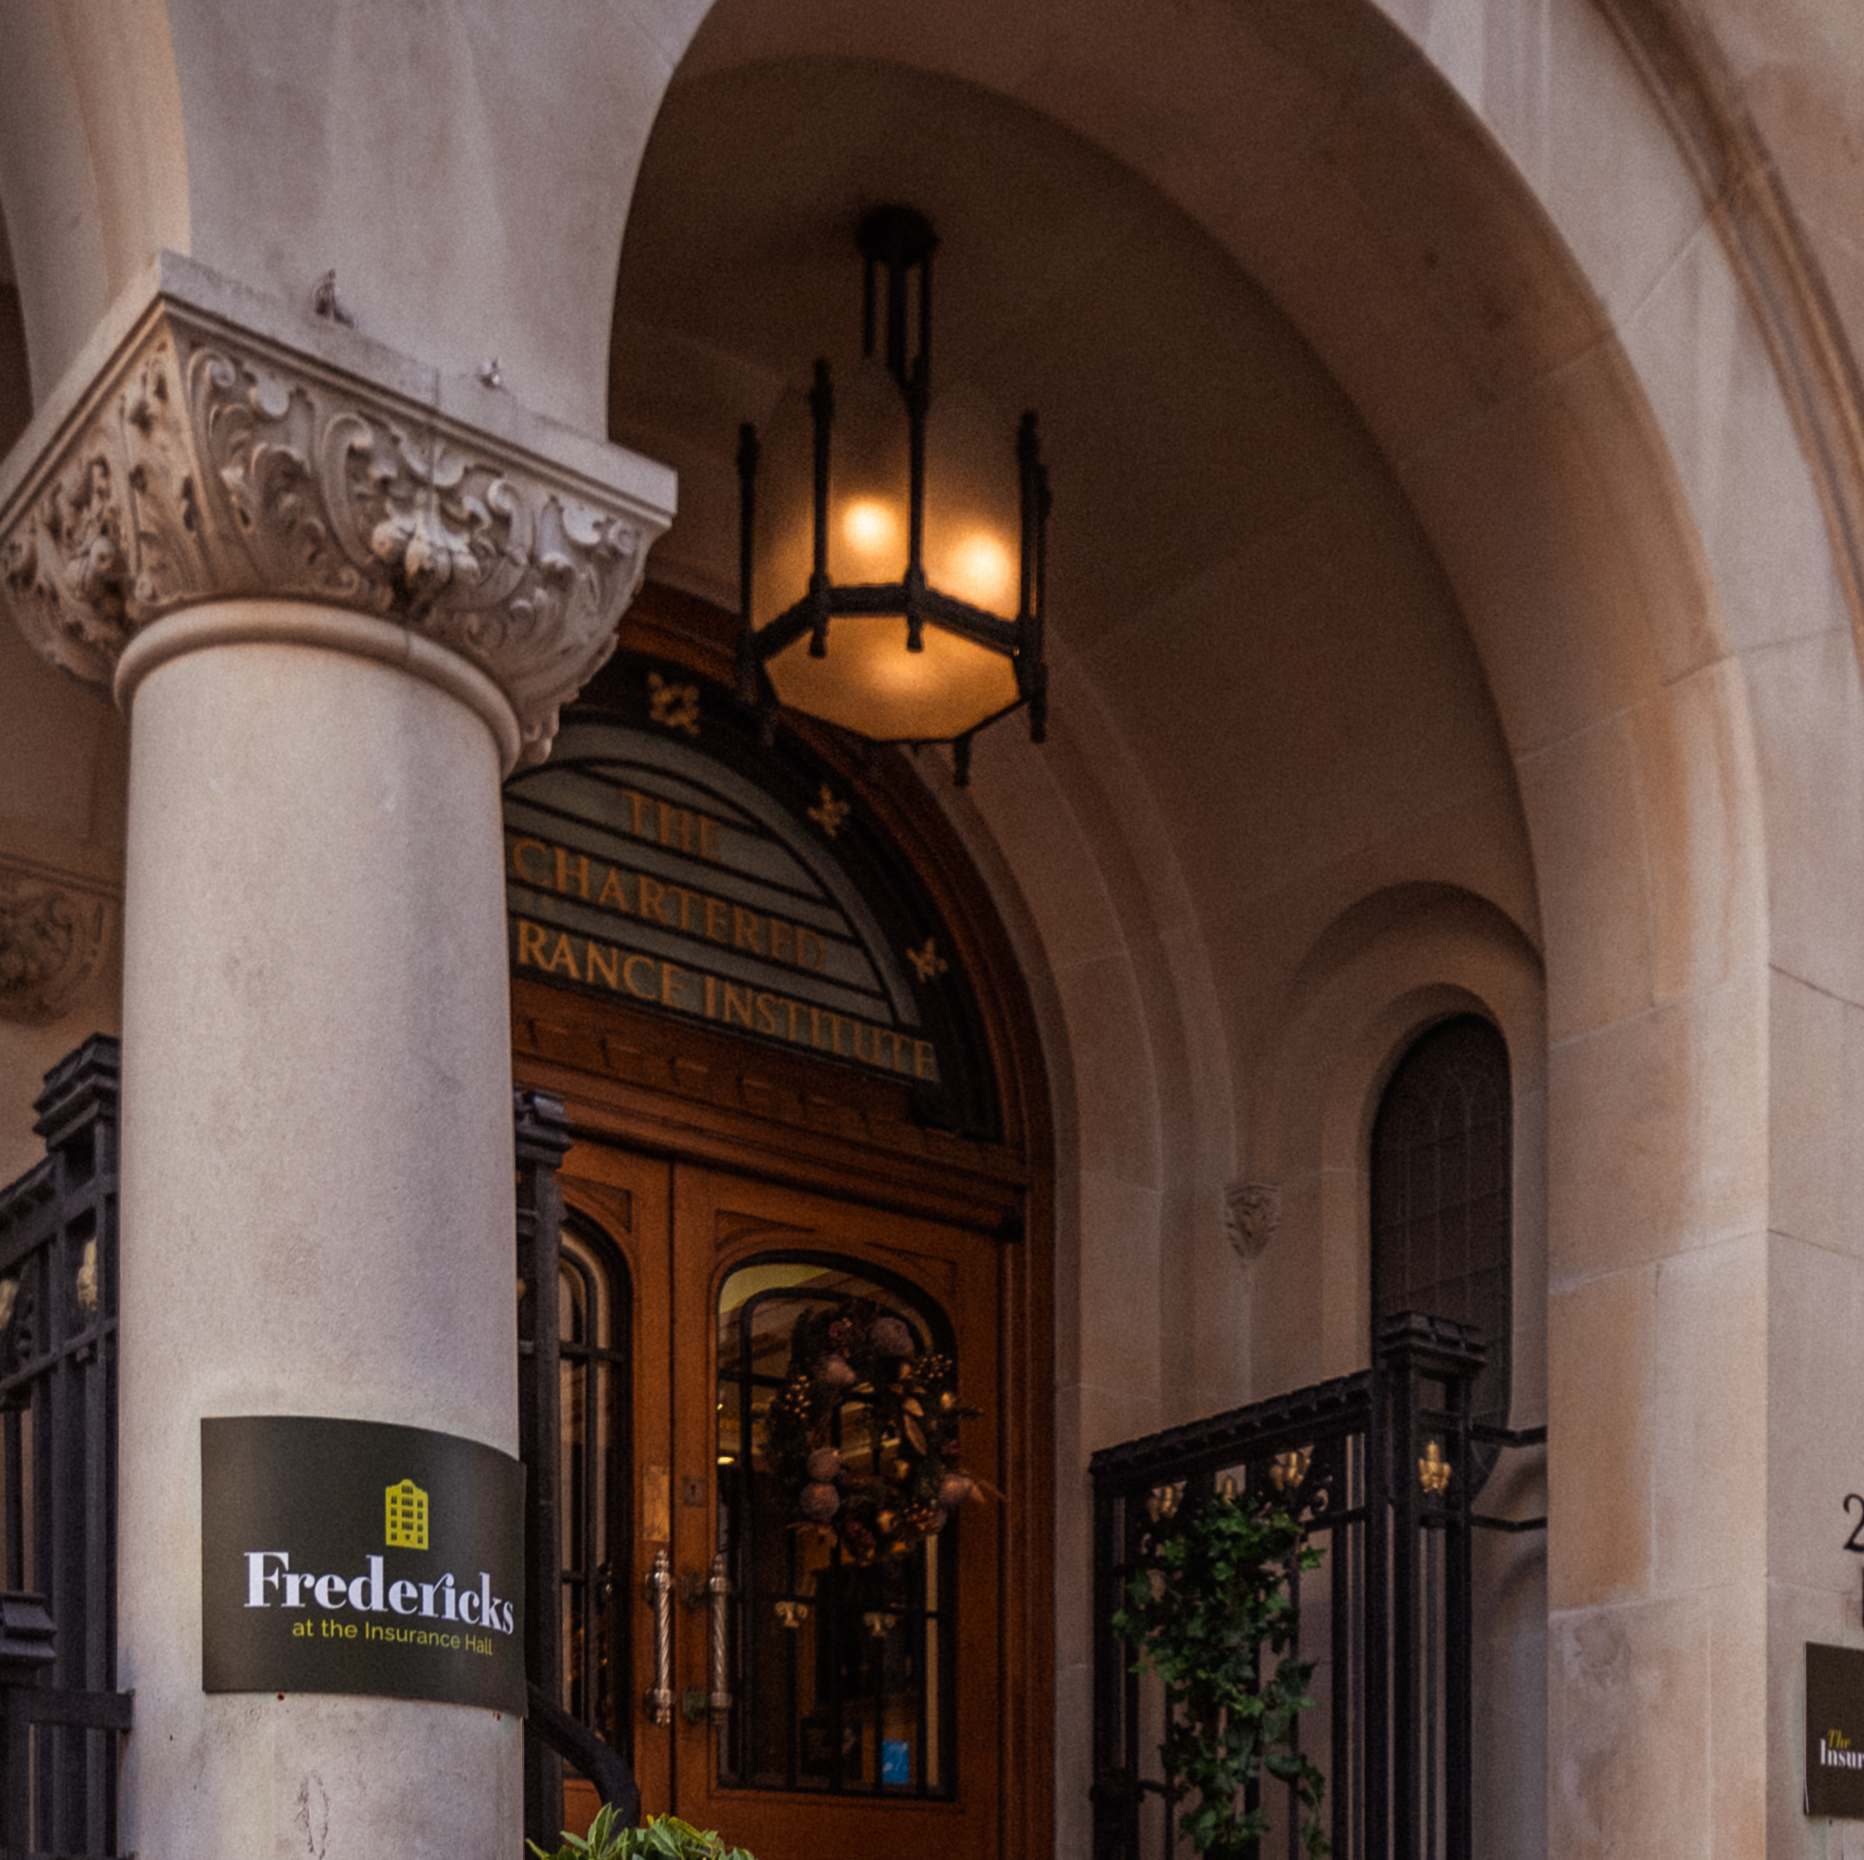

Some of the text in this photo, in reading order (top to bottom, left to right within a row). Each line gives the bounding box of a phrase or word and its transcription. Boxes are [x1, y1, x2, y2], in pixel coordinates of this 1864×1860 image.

[617, 787, 723, 863] THE
[512, 837, 827, 973] CHARTERED
[516, 919, 936, 1082] RANCE INSTITUTE
[243, 1551, 514, 1635] Fredericks
[291, 1618, 493, 1656] at the Insurance Hall
[1827, 1729, 1851, 1750] The
